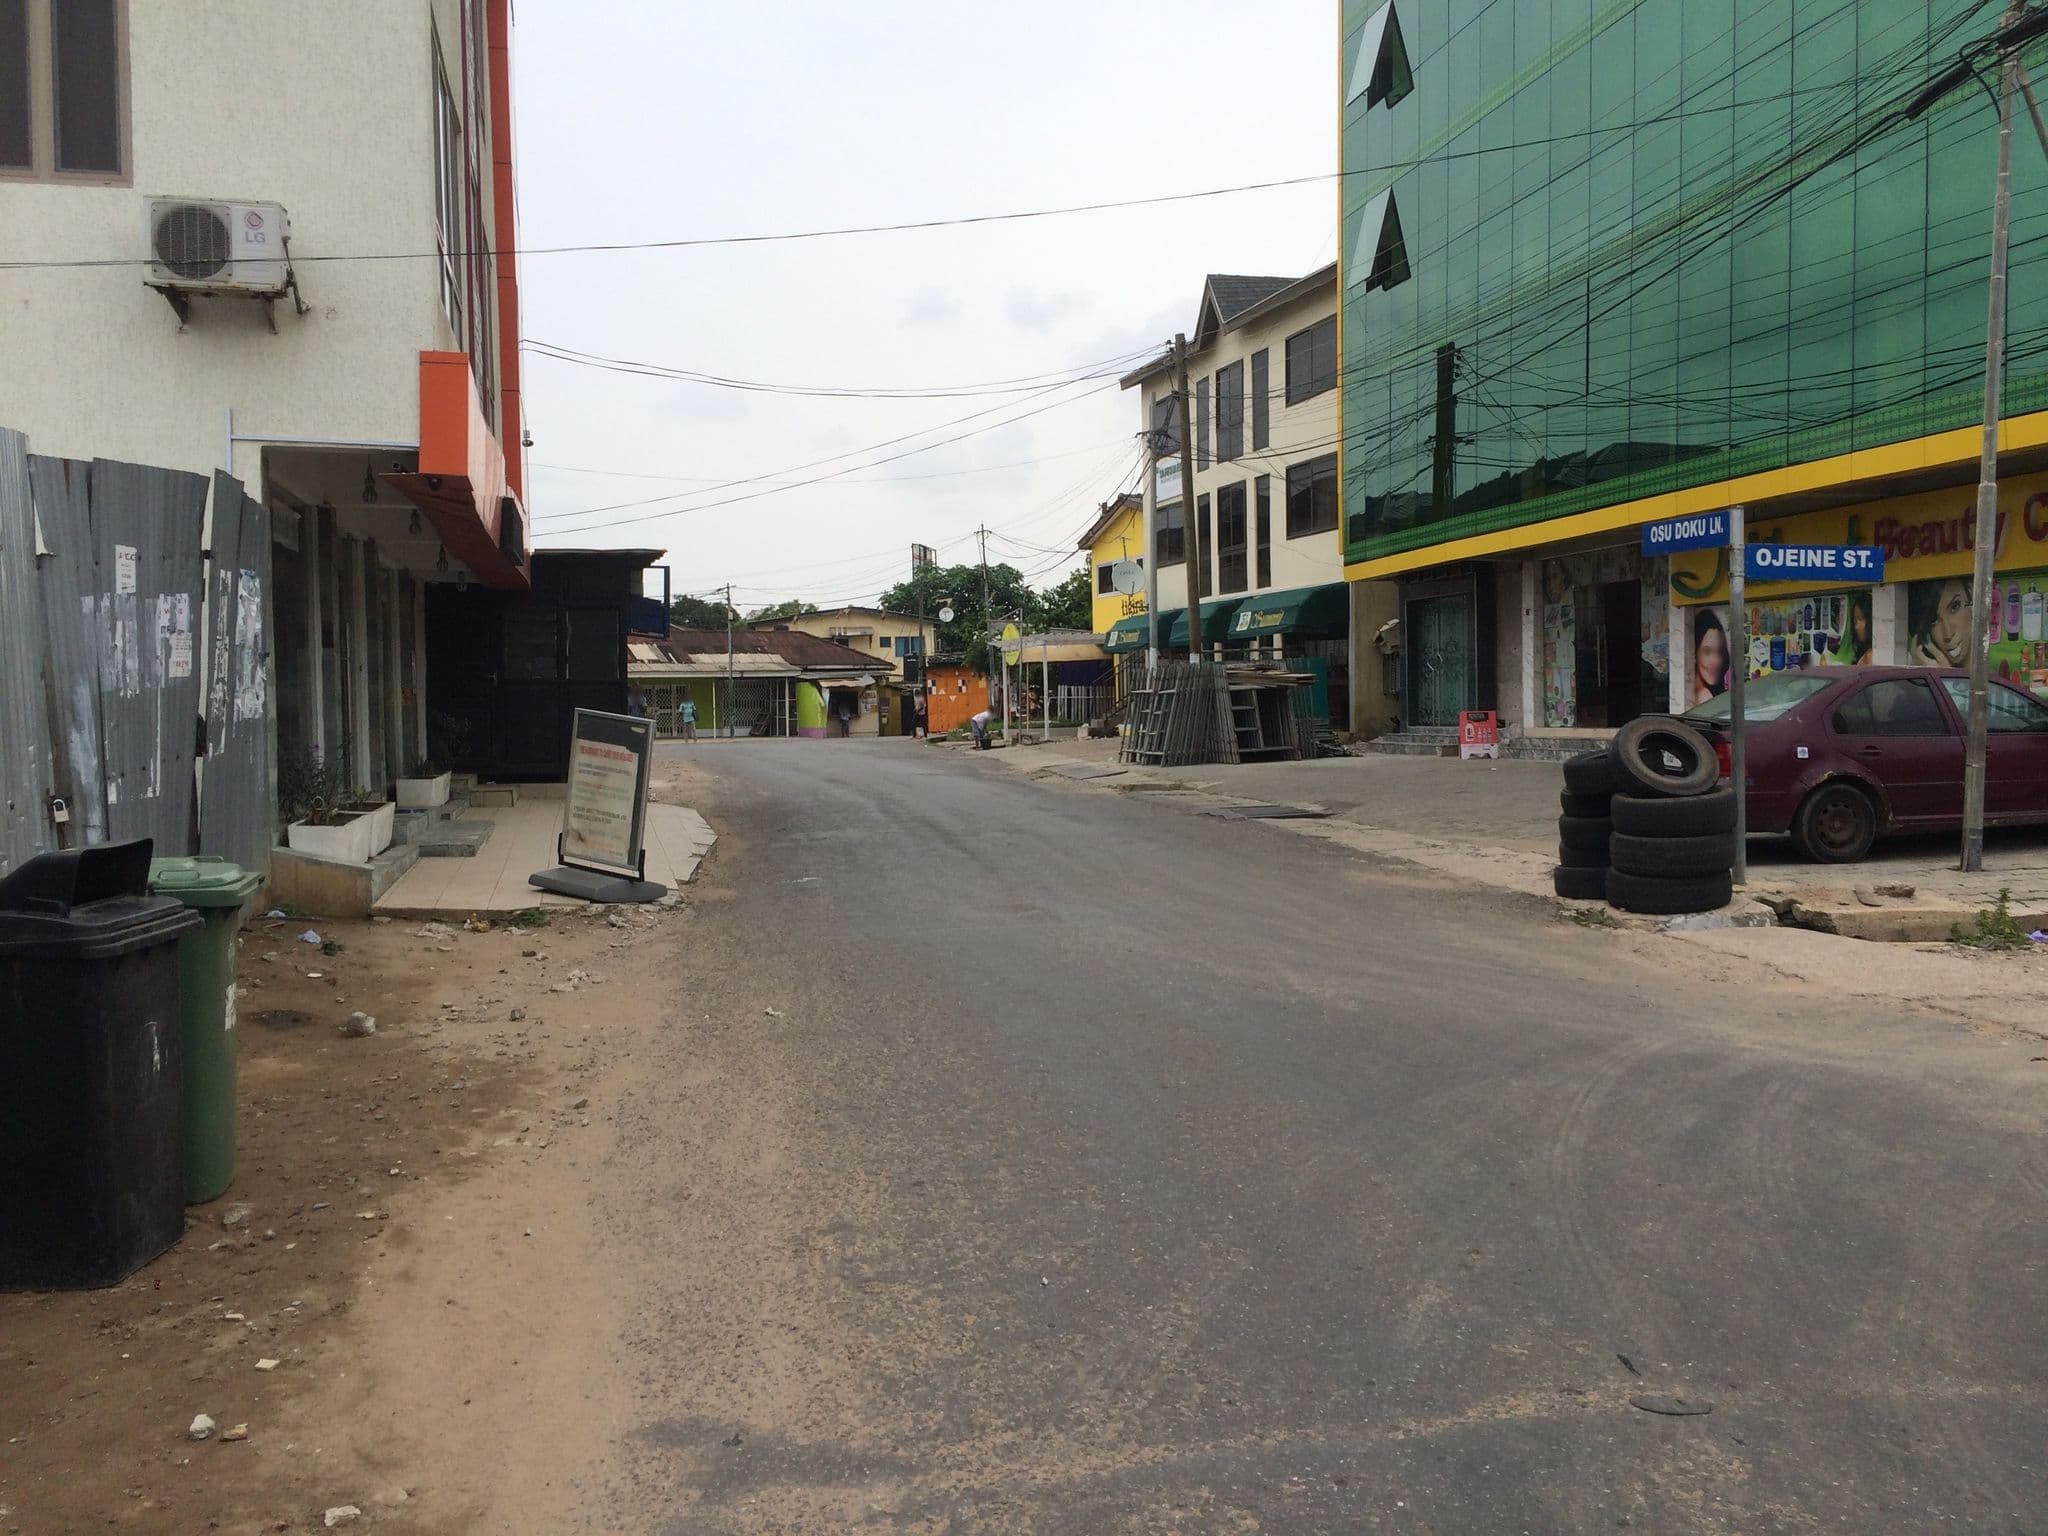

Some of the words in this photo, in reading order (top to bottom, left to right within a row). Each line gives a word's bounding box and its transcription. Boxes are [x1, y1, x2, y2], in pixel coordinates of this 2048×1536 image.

[245, 231, 266, 243] LG
[1650, 523, 1672, 543] OSU
[1675, 518, 1706, 540] DOKU
[1709, 515, 1724, 536] LN.
[1755, 548, 1836, 568] OJEINE
[1843, 549, 1874, 568] ST.
